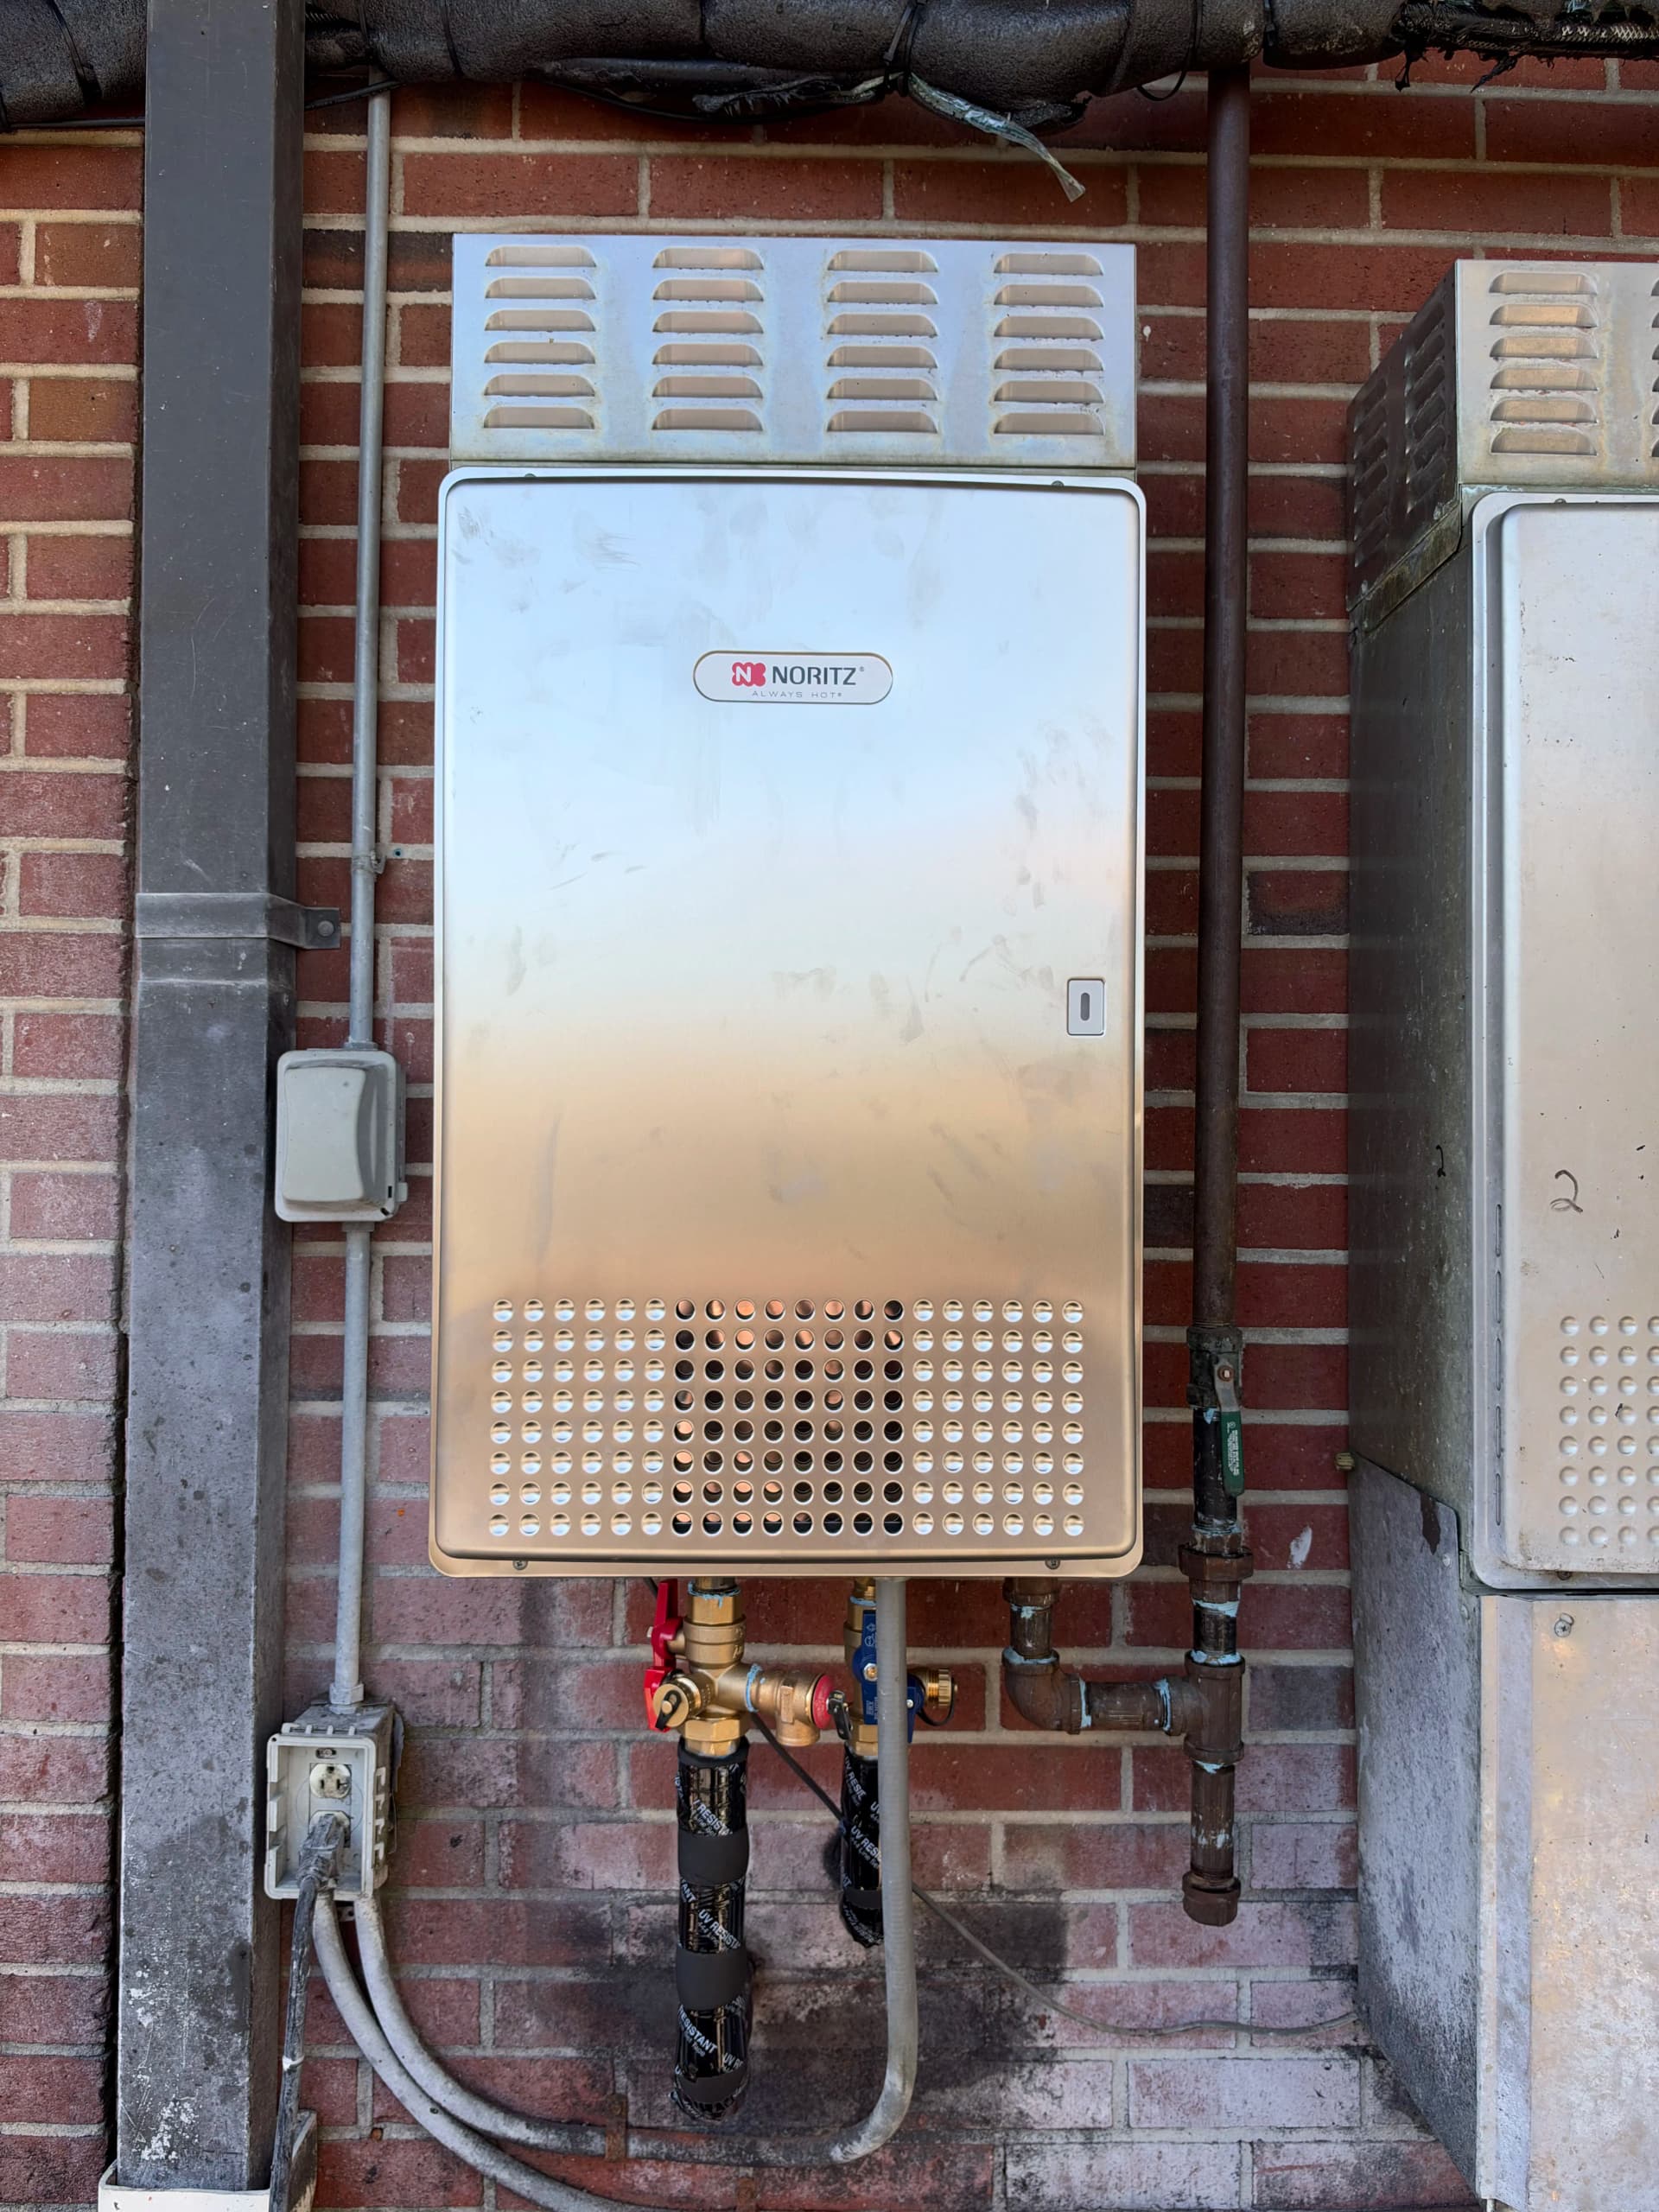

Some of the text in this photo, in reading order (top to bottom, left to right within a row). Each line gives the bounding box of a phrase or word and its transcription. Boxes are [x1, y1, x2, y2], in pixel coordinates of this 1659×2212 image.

[772, 665, 857, 686] NORITZ
[752, 690, 804, 699] ALWAYS
[1549, 1169, 1584, 1214] 2
[850, 1824, 864, 1840] UV
[698, 1909, 714, 1924] UV
